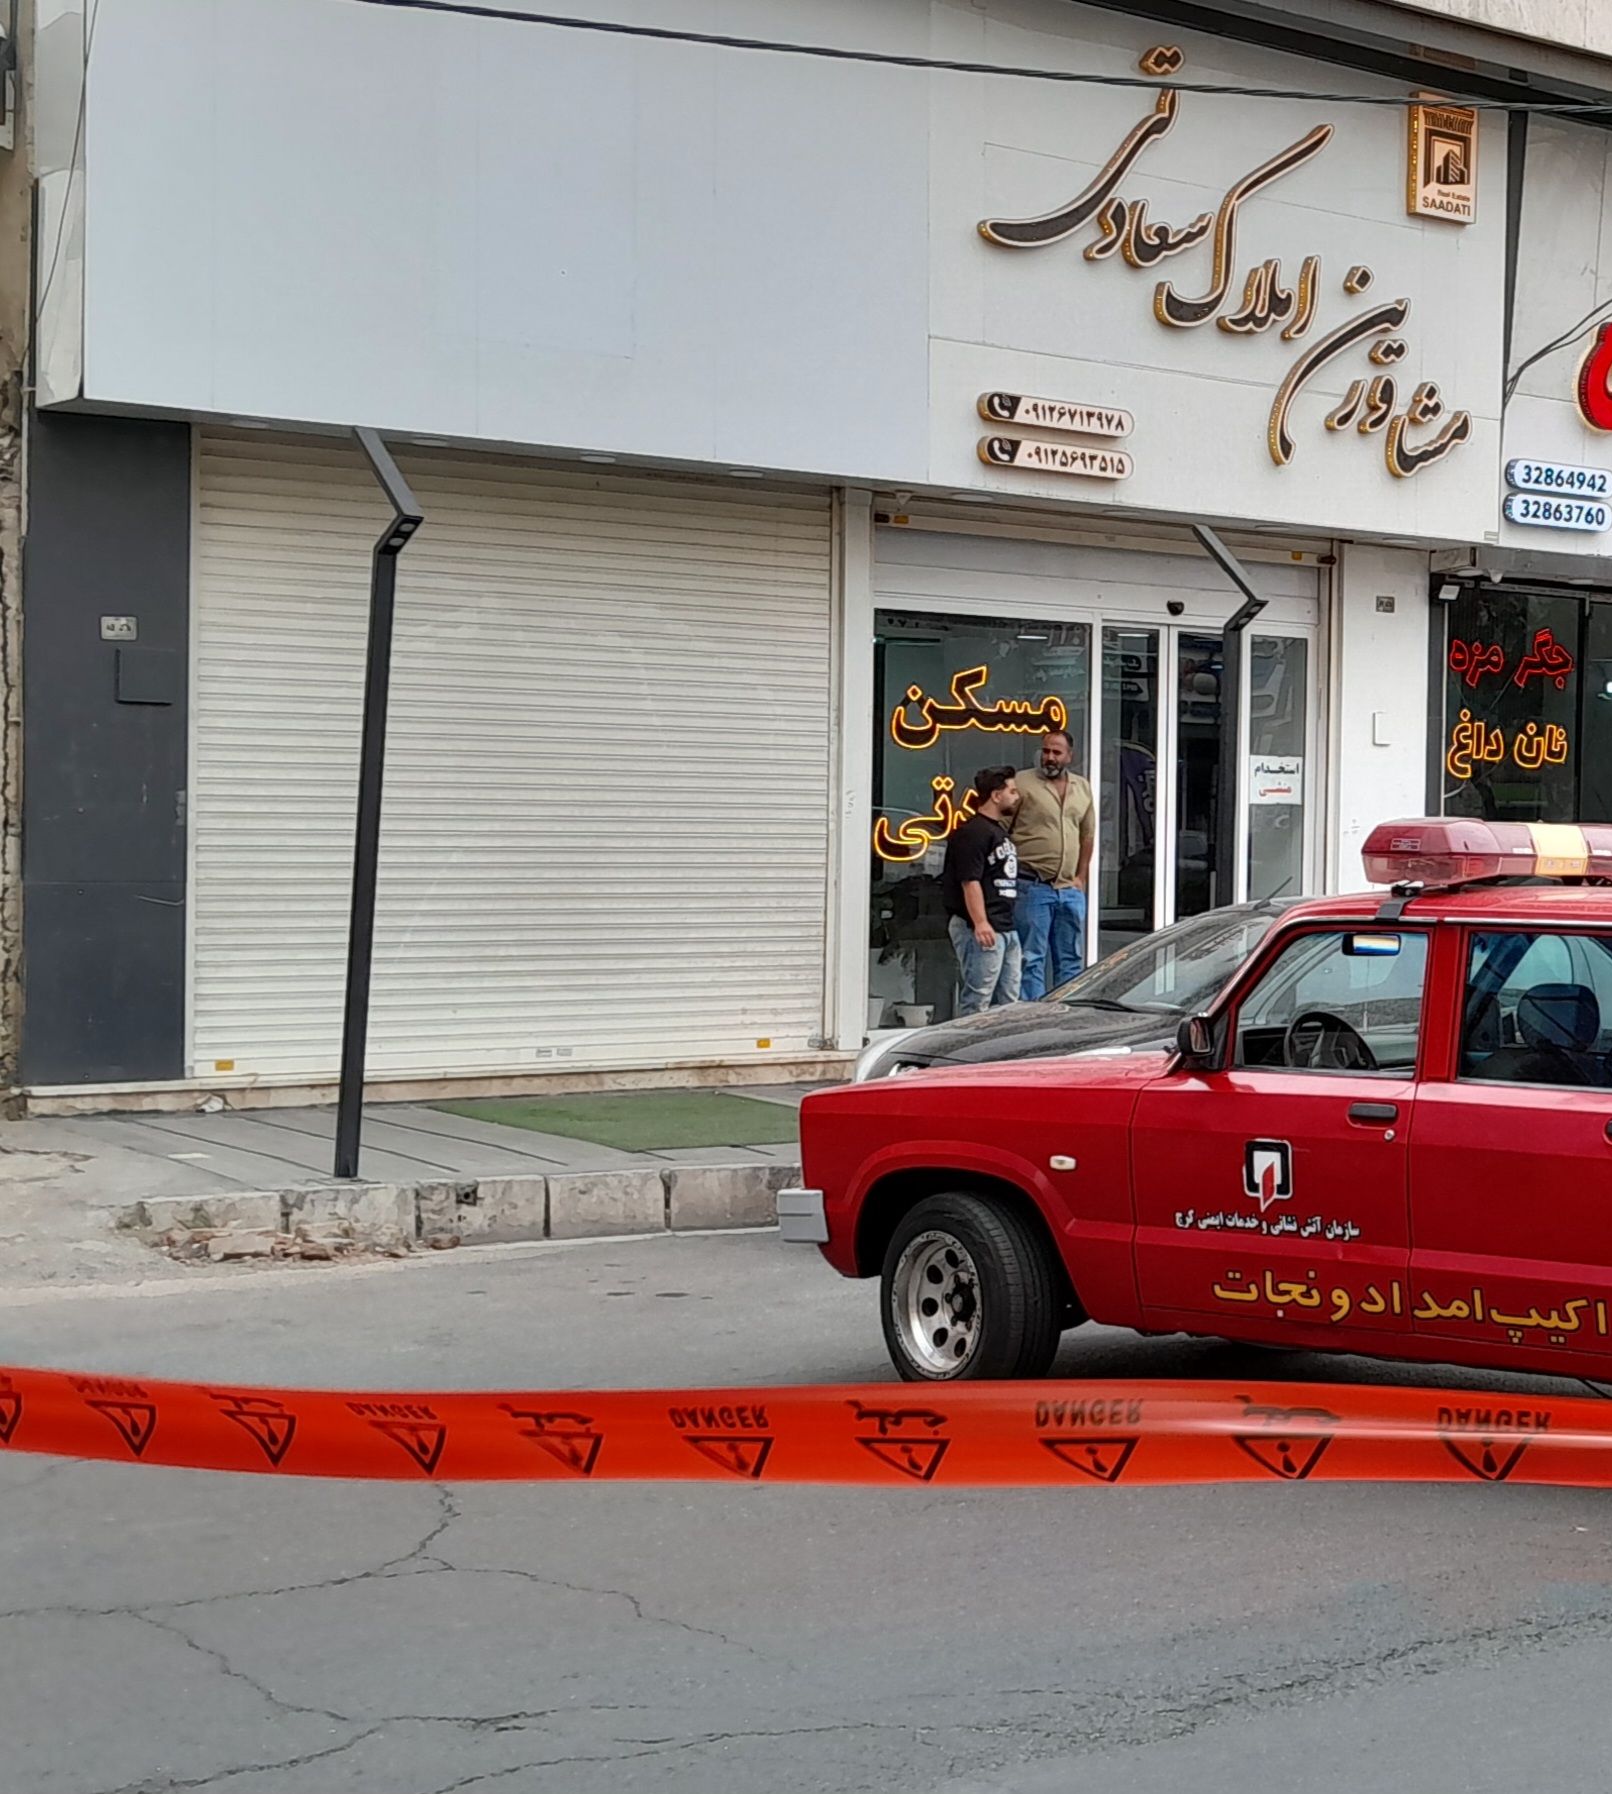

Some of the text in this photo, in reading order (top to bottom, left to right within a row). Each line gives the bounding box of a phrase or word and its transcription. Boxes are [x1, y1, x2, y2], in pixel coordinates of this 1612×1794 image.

[1422, 195, 1471, 217] SAADATI
[1154, 123, 1335, 340] املاک
[1521, 464, 1607, 493] 32864942
[1519, 499, 1605, 526] 32863760
[1450, 628, 1574, 689] جگر مزه
[891, 664, 1067, 750] مسکن
[1447, 708, 1568, 778] نان داغ
[1254, 762, 1299, 778] استخدام
[1175, 1209, 1360, 1241] سازمان آتش نشانی و خدمات ایمنی کرج
[1213, 1270, 1322, 1318] نجات
[1330, 1286, 1352, 1322] و
